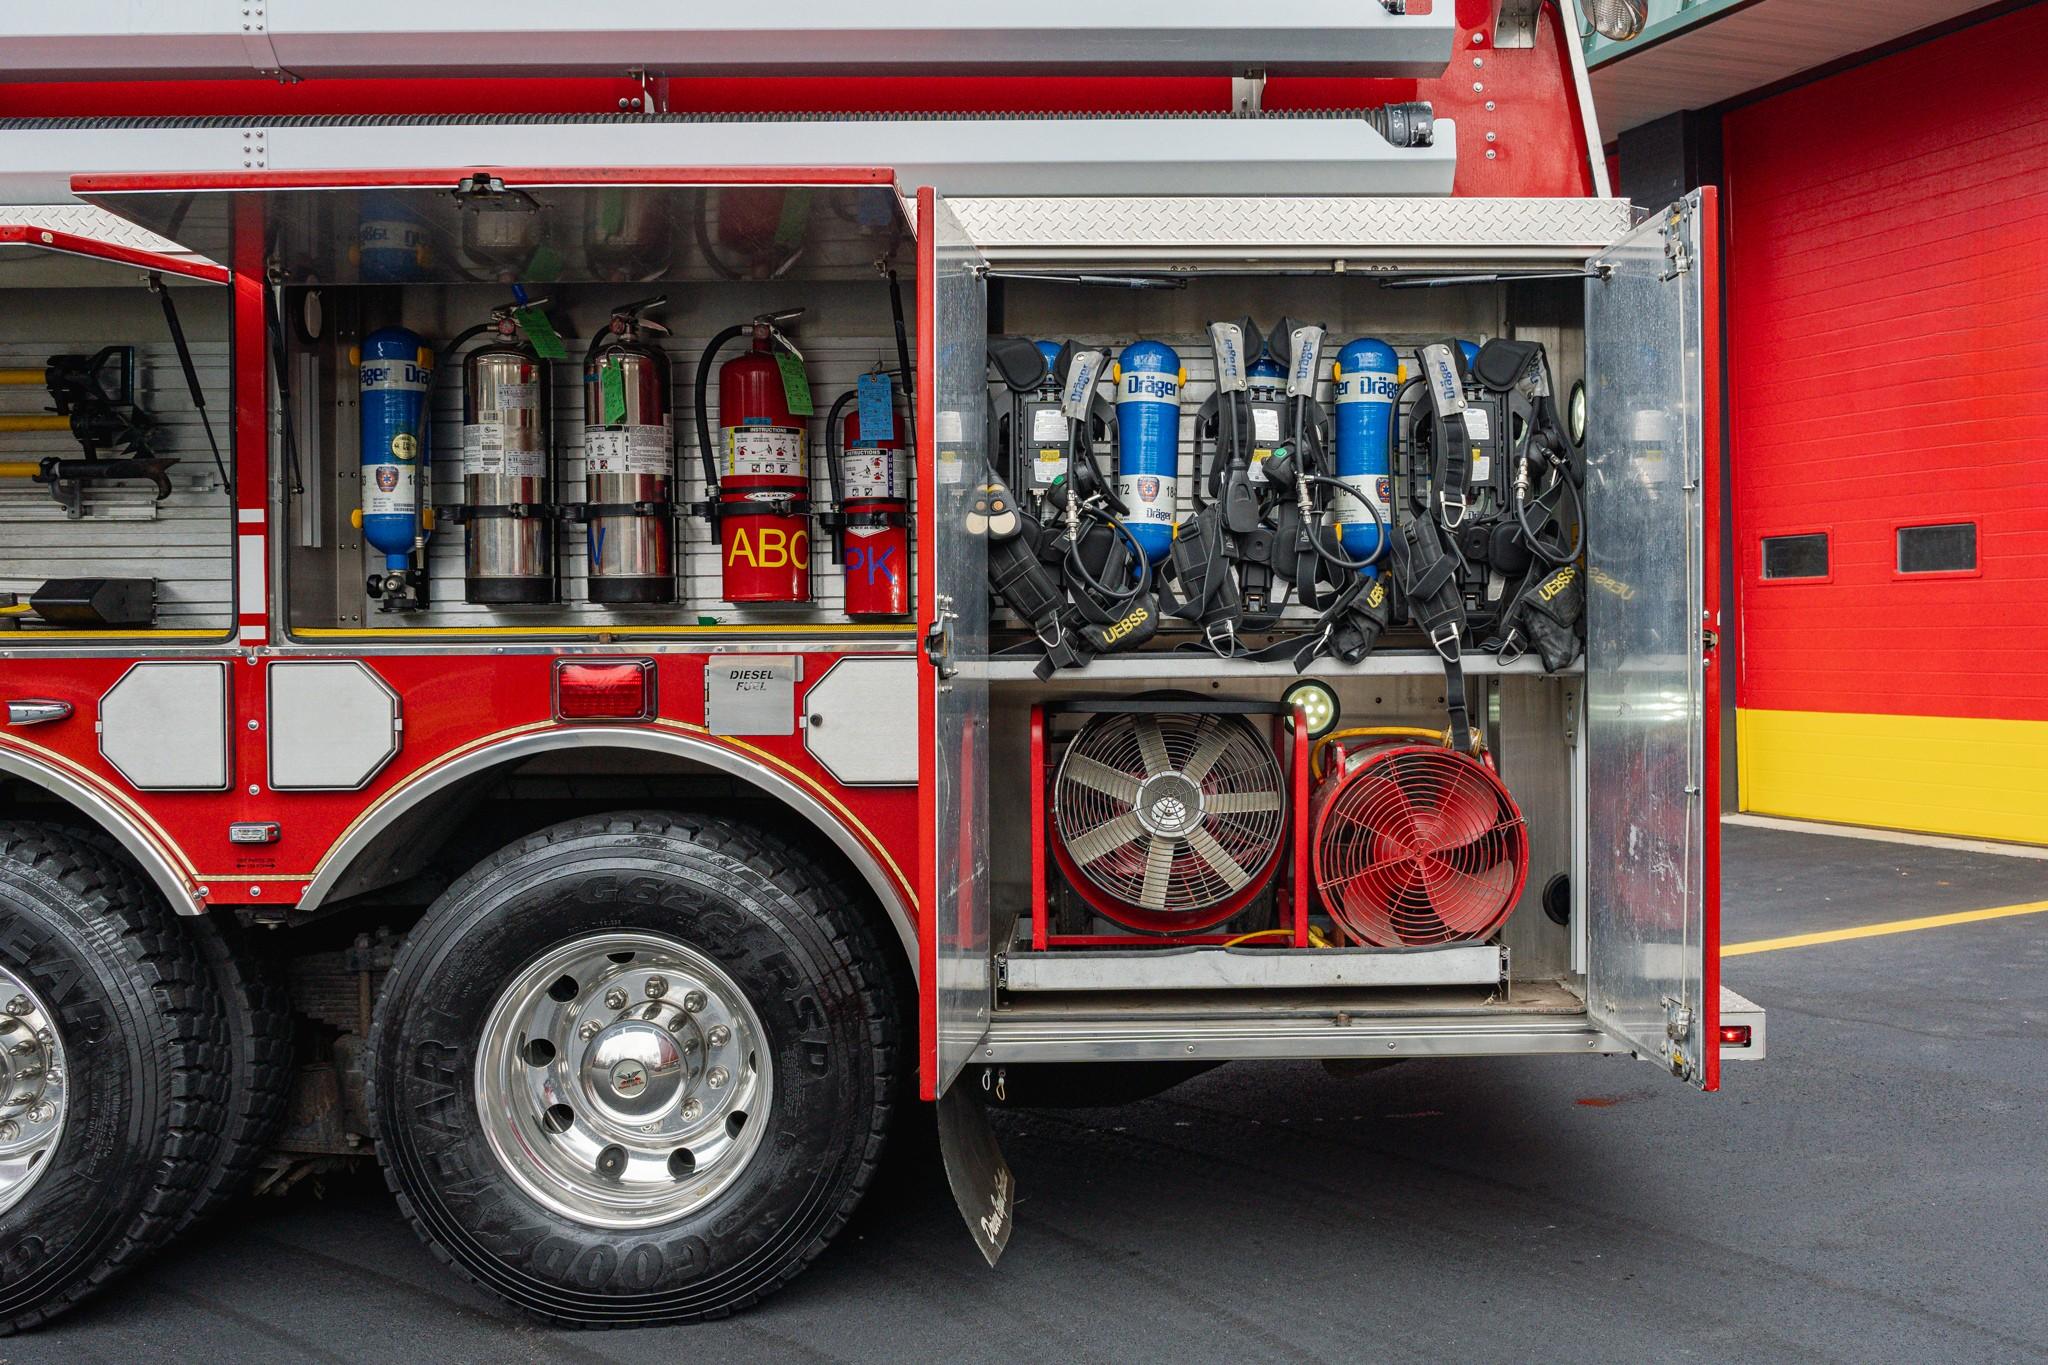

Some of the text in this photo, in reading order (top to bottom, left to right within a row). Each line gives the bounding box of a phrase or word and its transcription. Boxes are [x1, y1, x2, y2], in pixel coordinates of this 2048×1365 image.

[1070, 363, 1091, 403] Dräger
[1128, 375, 1178, 398] Dräger
[1439, 359, 1456, 400] Dräger
[623, 425, 631, 472] WATER
[1146, 507, 1171, 521] Dräger
[728, 528, 808, 569] ABC
[1539, 566, 1576, 601] UEBSS
[1102, 607, 1150, 644] UEBSS
[729, 670, 774, 680] DIESEL
[578, 873, 749, 938] G622
